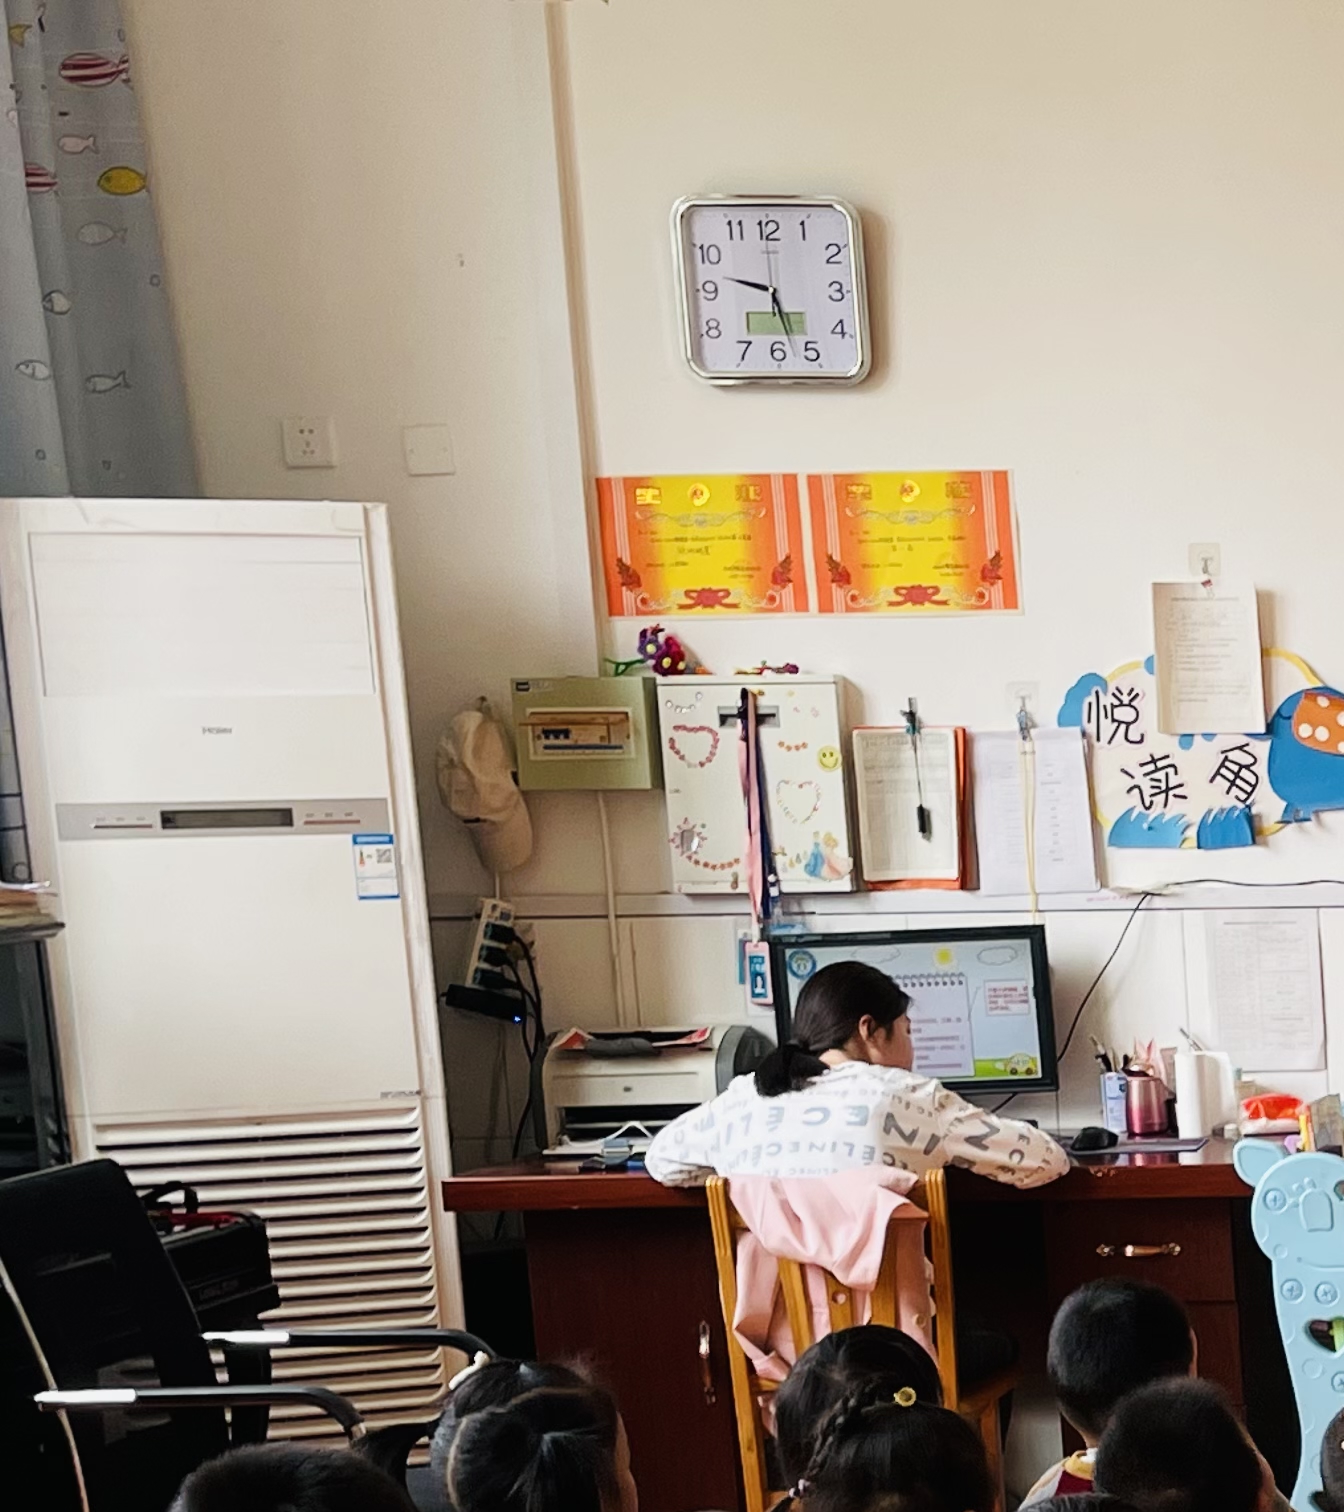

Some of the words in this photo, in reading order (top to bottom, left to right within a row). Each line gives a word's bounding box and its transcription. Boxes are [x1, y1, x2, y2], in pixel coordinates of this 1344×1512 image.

[726, 219, 745, 242] 11
[756, 220, 781, 243] 12
[798, 219, 808, 242] 1
[698, 244, 722, 265] 10
[825, 243, 843, 265] 2
[702, 280, 719, 301] 9
[828, 281, 846, 303] 3
[704, 318, 722, 339] 8
[830, 318, 848, 339] 4
[736, 340, 753, 362] 7
[769, 340, 787, 362] 6
[803, 340, 821, 362] 5
